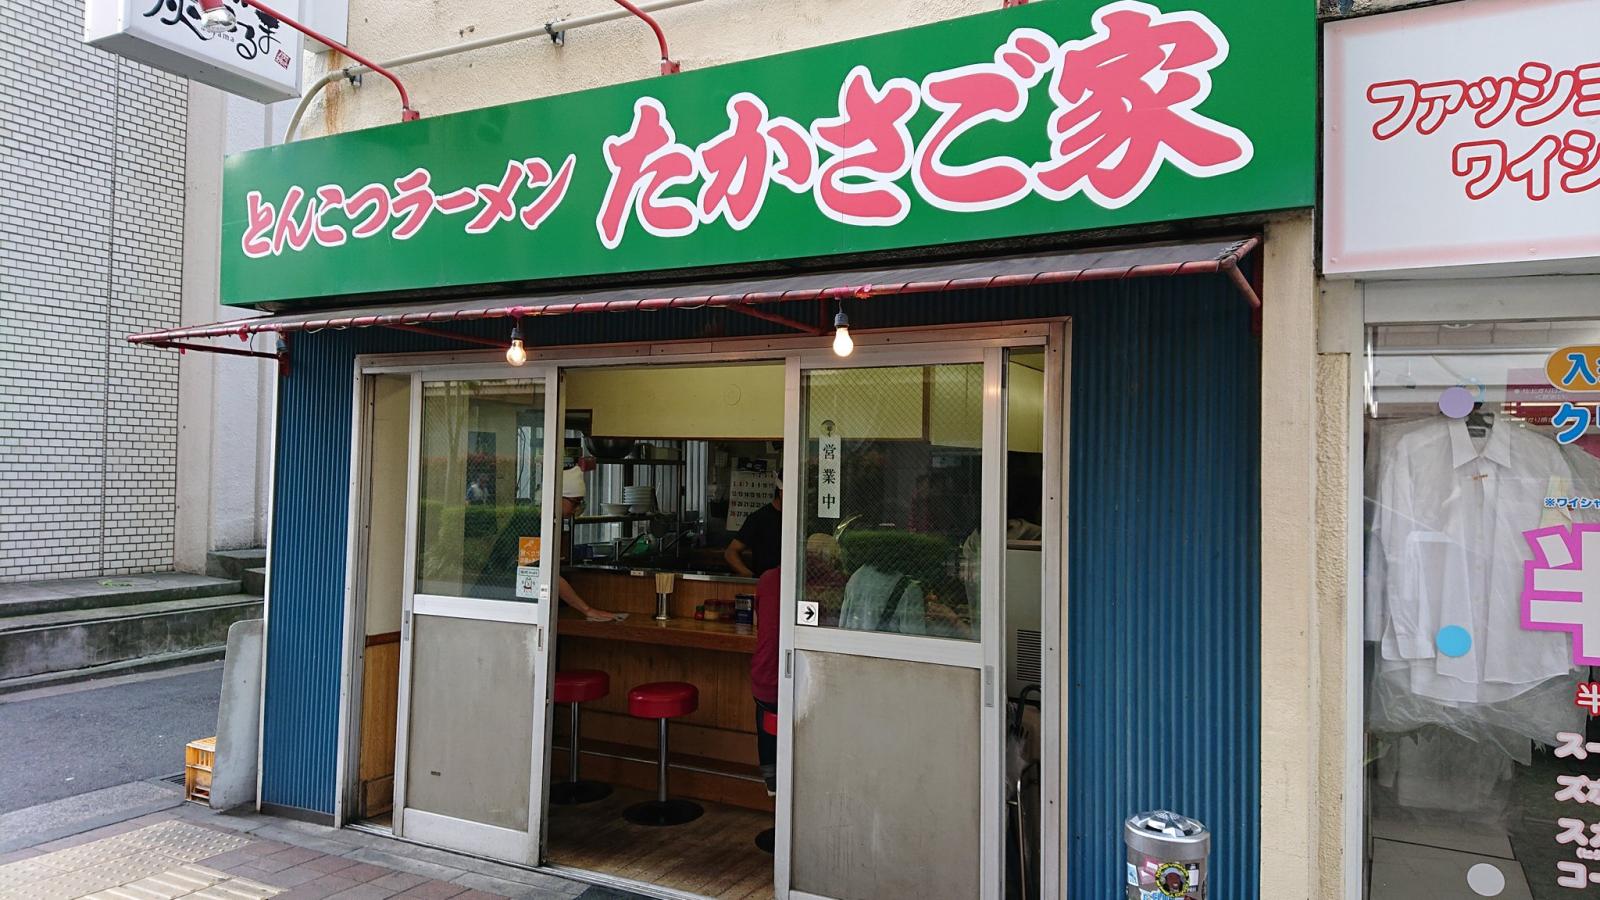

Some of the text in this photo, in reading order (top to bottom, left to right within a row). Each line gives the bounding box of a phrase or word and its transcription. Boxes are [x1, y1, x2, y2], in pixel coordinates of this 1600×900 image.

[243, 0, 1254, 258] とんこつラーメン たかさご家
[1562, 353, 1600, 385] 入
[822, 443, 837, 509] 営業中
